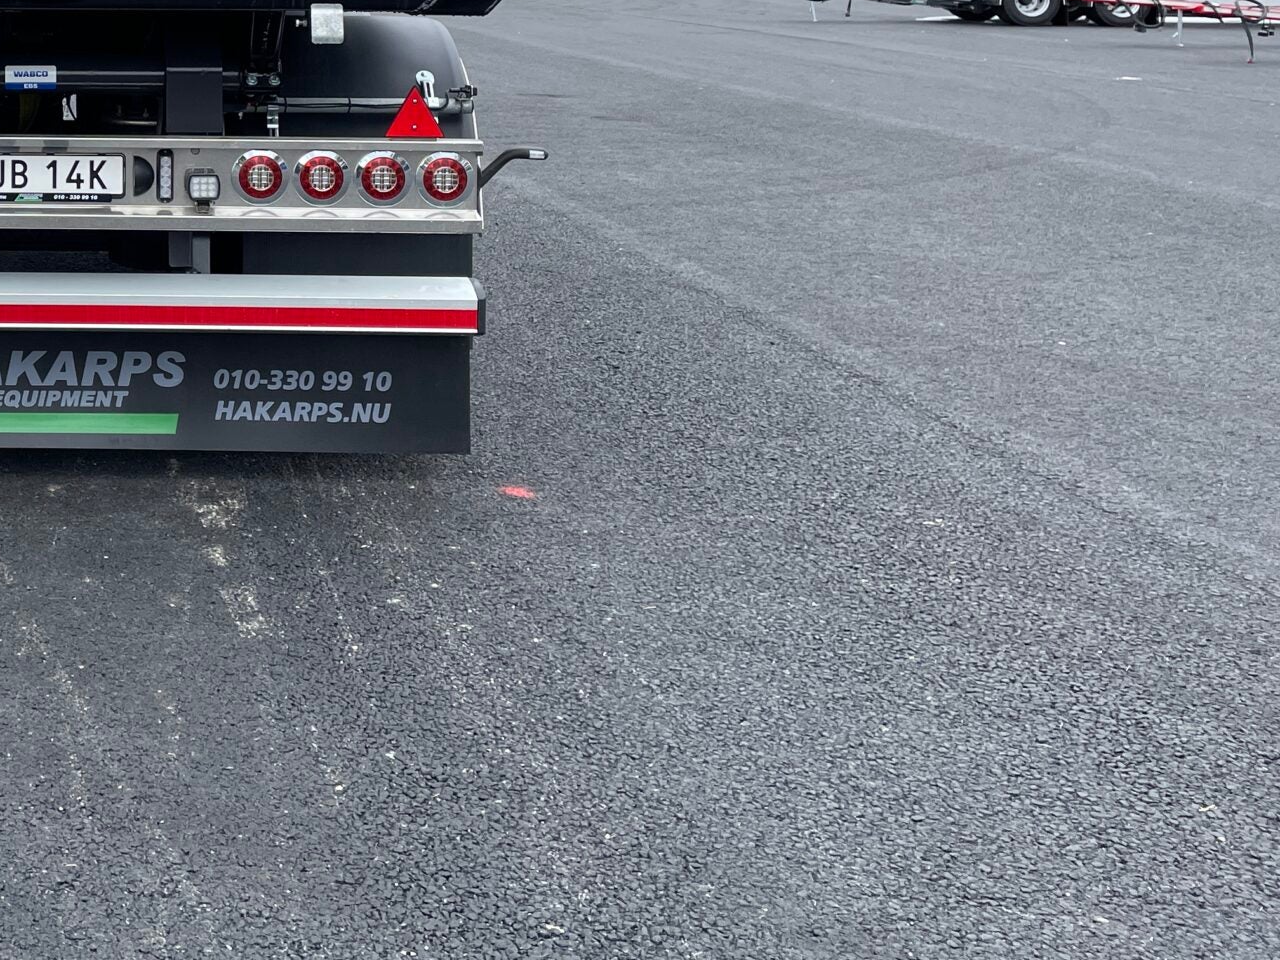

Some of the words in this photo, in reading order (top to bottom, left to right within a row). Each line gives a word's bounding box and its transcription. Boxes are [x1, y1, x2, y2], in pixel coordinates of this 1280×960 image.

[46, 159, 107, 189] 14K
[214, 369, 315, 391] 010-330
[321, 371, 353, 391] 99
[362, 371, 393, 392] 10
[214, 400, 392, 424] HAKARPS.NU
